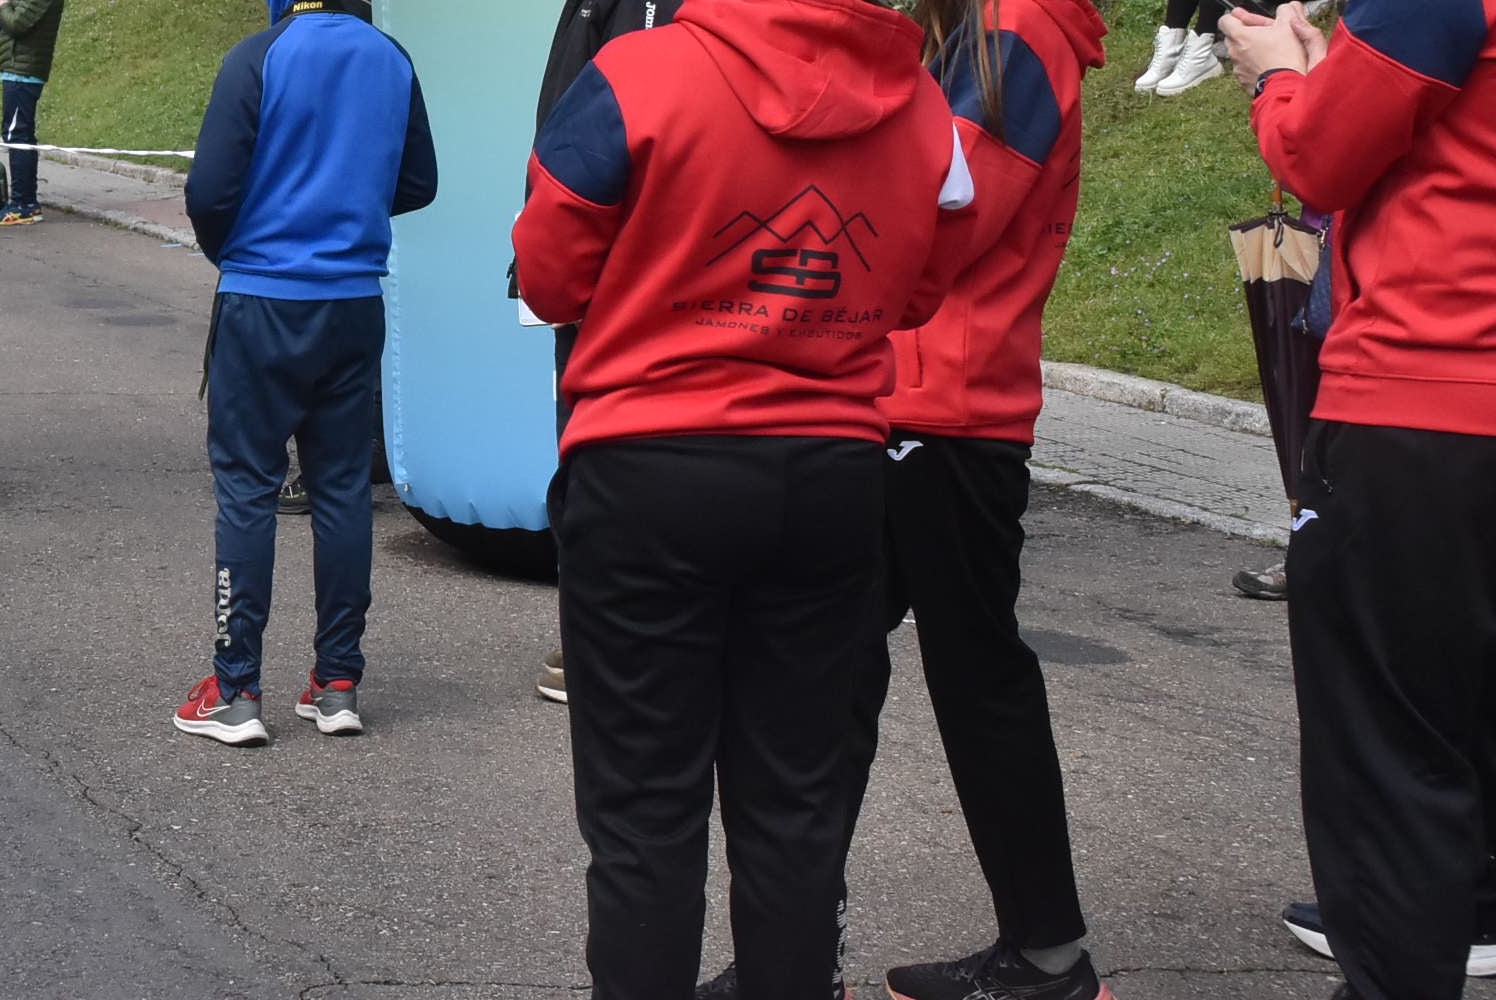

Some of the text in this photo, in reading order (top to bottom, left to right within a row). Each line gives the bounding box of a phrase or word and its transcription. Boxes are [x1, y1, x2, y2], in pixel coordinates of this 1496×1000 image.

[292, 1, 323, 13] Nikon
[645, 1, 656, 30] Jom
[672, 300, 884, 324] SIERRA DE BÉJAR
[695, 319, 770, 336] JAMONES
